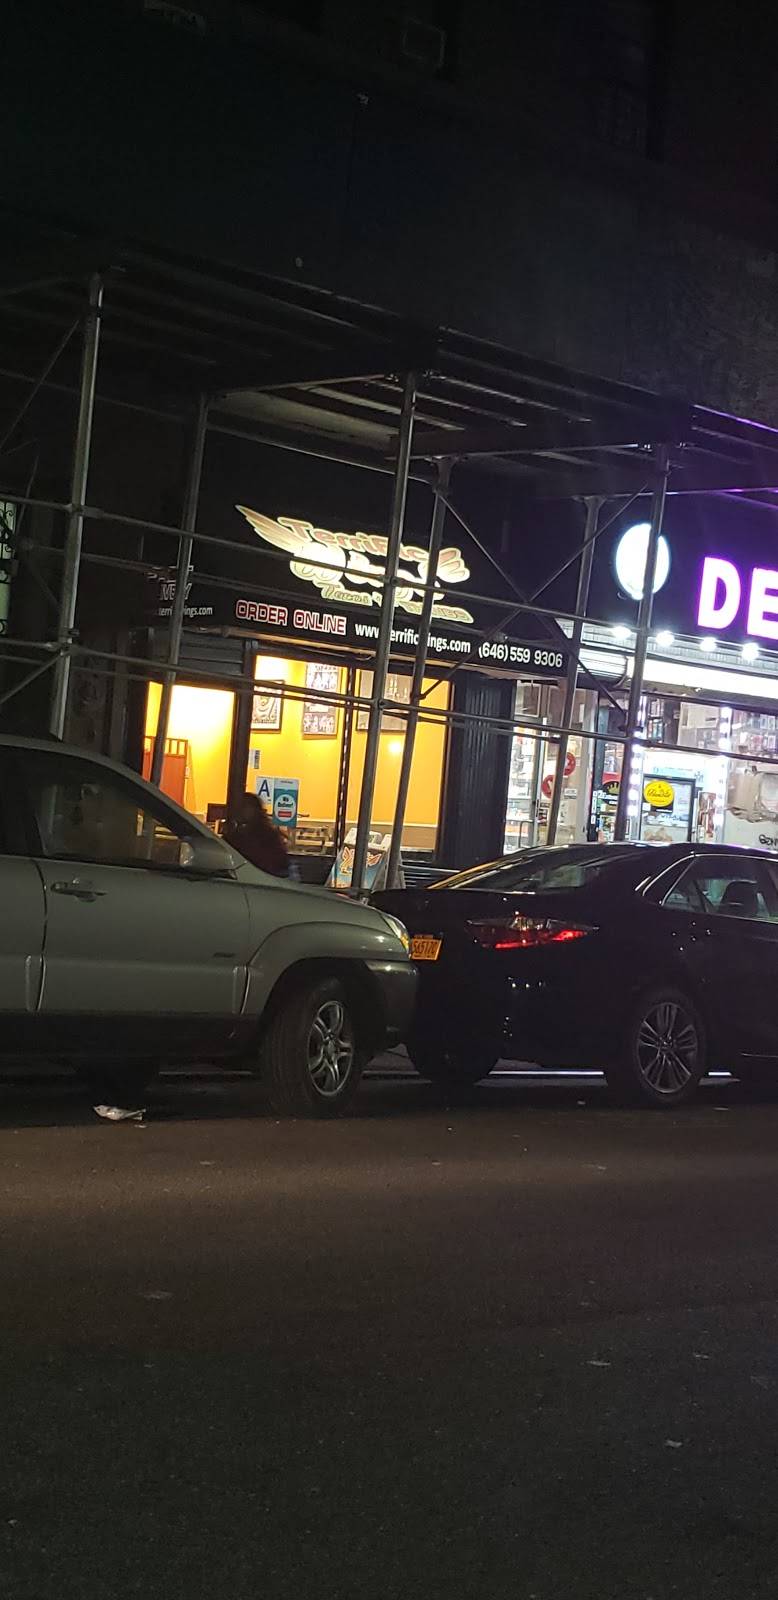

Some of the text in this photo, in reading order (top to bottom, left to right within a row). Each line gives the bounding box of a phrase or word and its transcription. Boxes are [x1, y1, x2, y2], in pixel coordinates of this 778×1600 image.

[236, 600, 288, 626] ORDER
[293, 609, 347, 635] ONLINE
[534, 650, 563, 667] 9306
